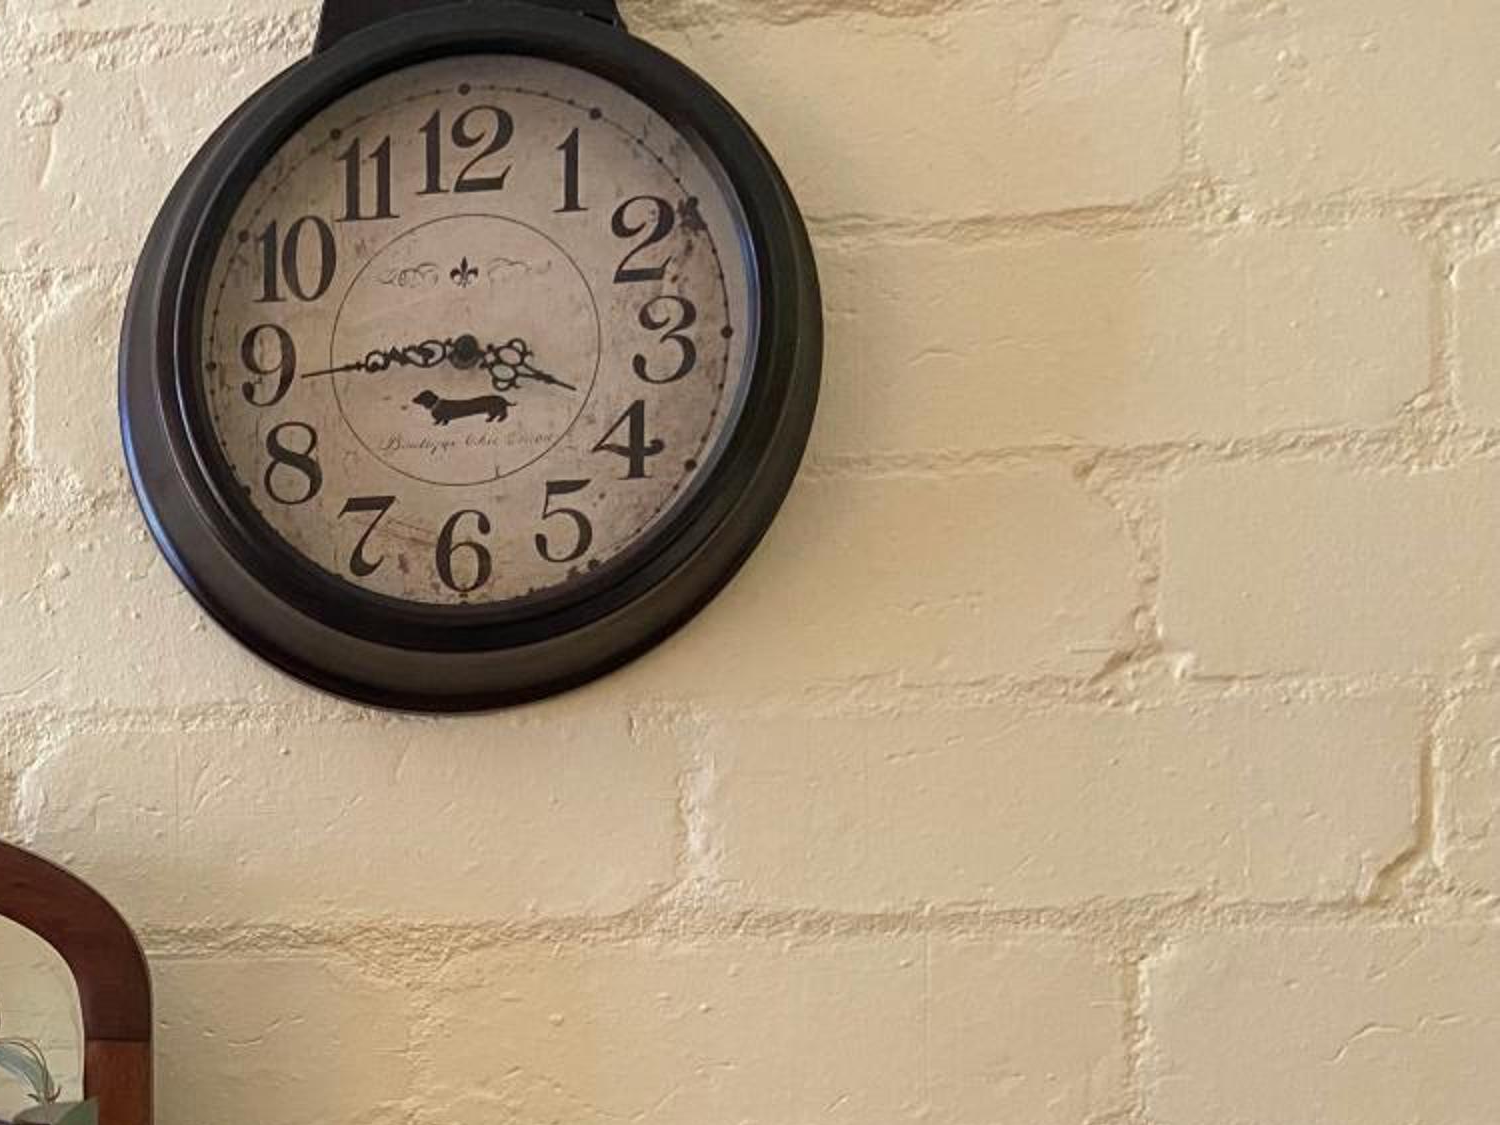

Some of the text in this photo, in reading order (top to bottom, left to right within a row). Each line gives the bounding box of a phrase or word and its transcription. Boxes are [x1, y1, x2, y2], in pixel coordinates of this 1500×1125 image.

[335, 136, 399, 223] 11
[416, 105, 514, 196] 12
[553, 128, 588, 213] 1
[252, 215, 337, 303] 10
[611, 195, 675, 284] 2
[241, 323, 296, 407] 9
[633, 296, 697, 385] 3
[264, 421, 323, 504] 8
[592, 400, 665, 480] 4
[339, 495, 396, 577] 7
[435, 508, 491, 593] 6
[534, 478, 592, 563] 5
